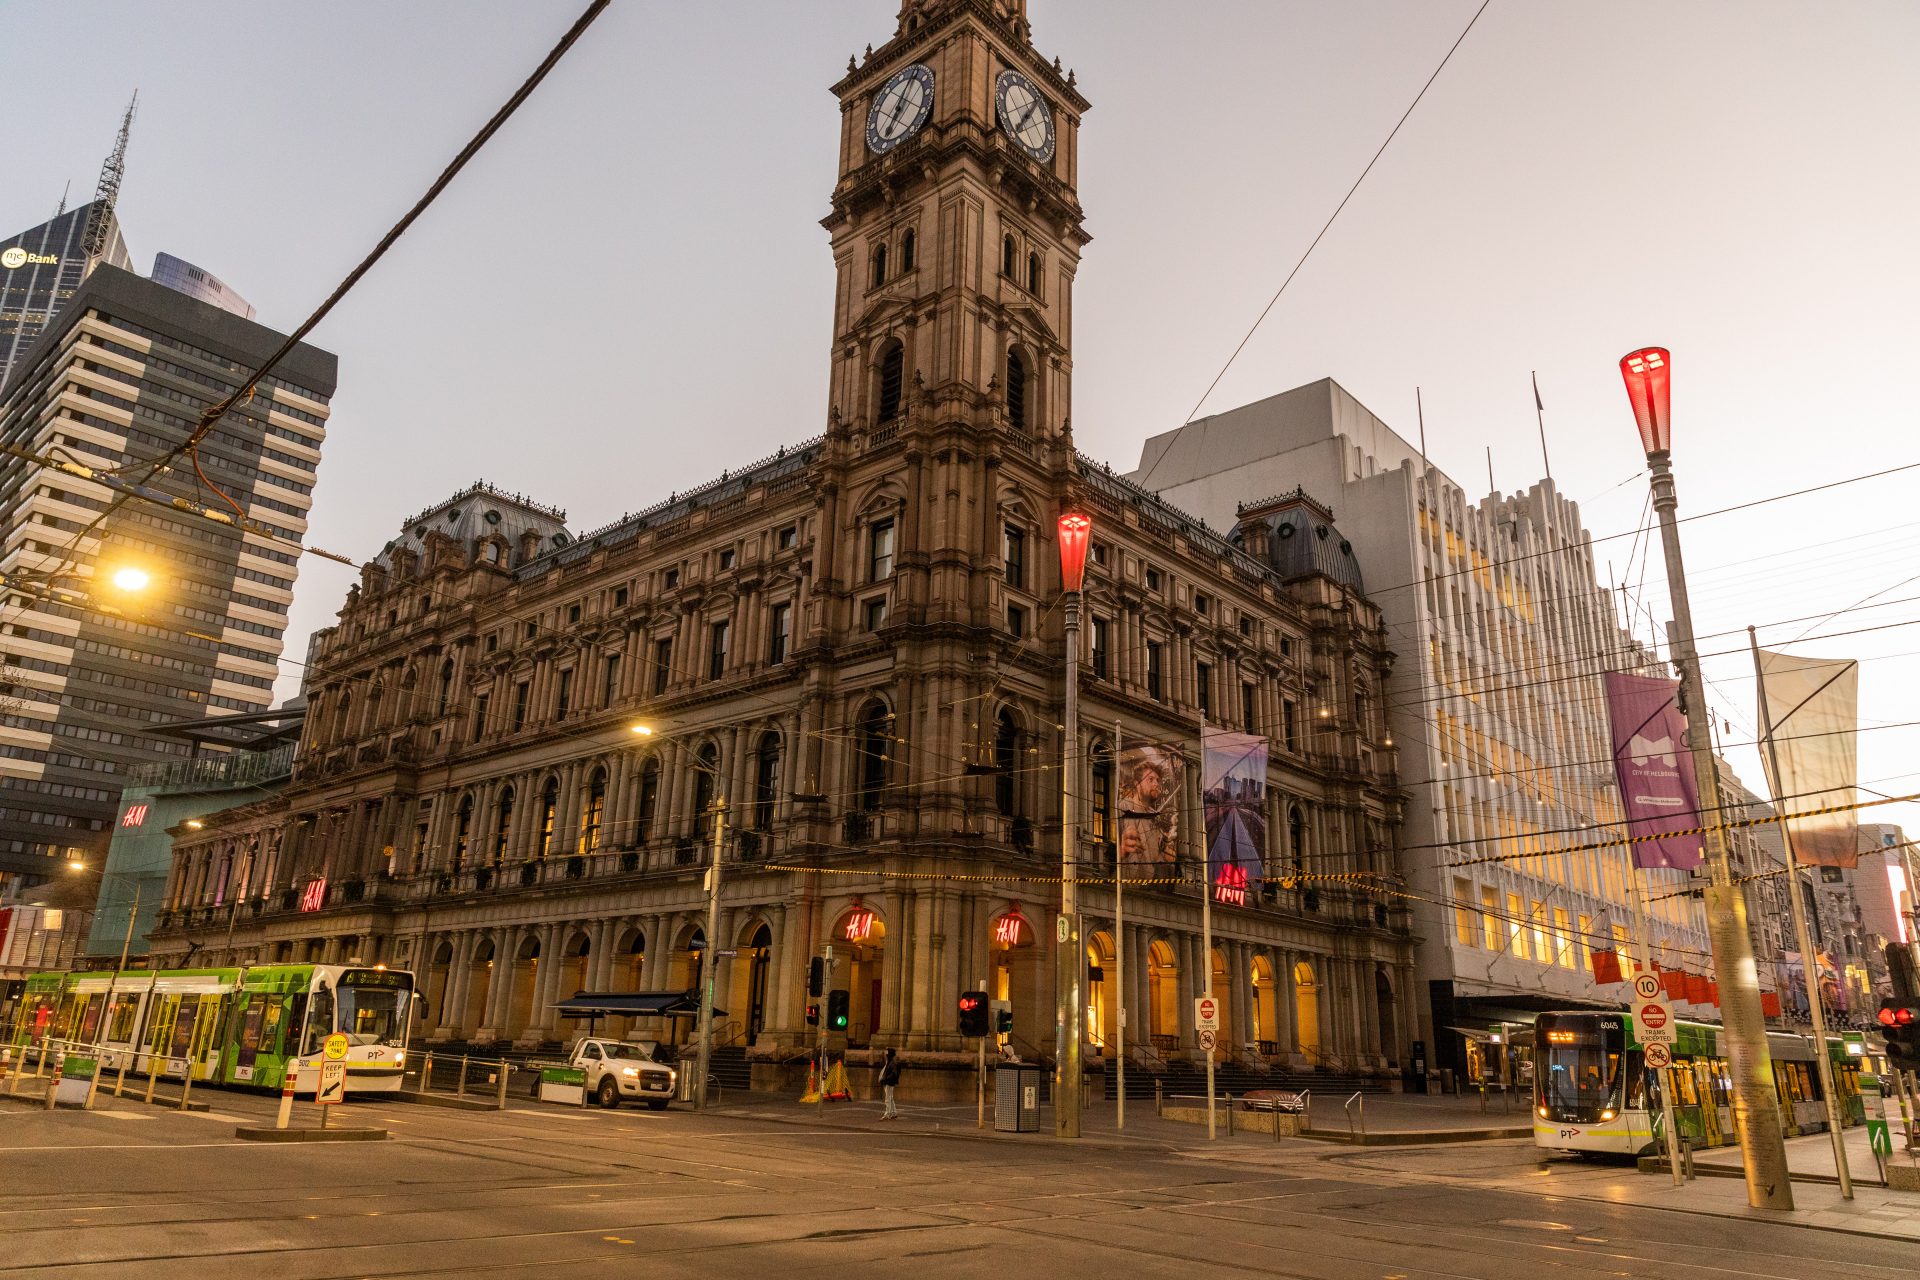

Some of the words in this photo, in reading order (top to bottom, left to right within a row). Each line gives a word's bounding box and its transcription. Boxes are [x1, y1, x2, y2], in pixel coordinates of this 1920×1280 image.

[26, 253, 59, 265] Bank
[122, 805, 148, 827] H&M
[301, 879, 327, 912] H&M
[1776, 876, 1788, 912] DAVID
[846, 912, 873, 939] H&M
[996, 918, 1020, 945] H&M
[1641, 980, 1655, 993] 10
[1600, 1021, 1619, 1030] 6045
[325, 1064, 342, 1072] KEEP
